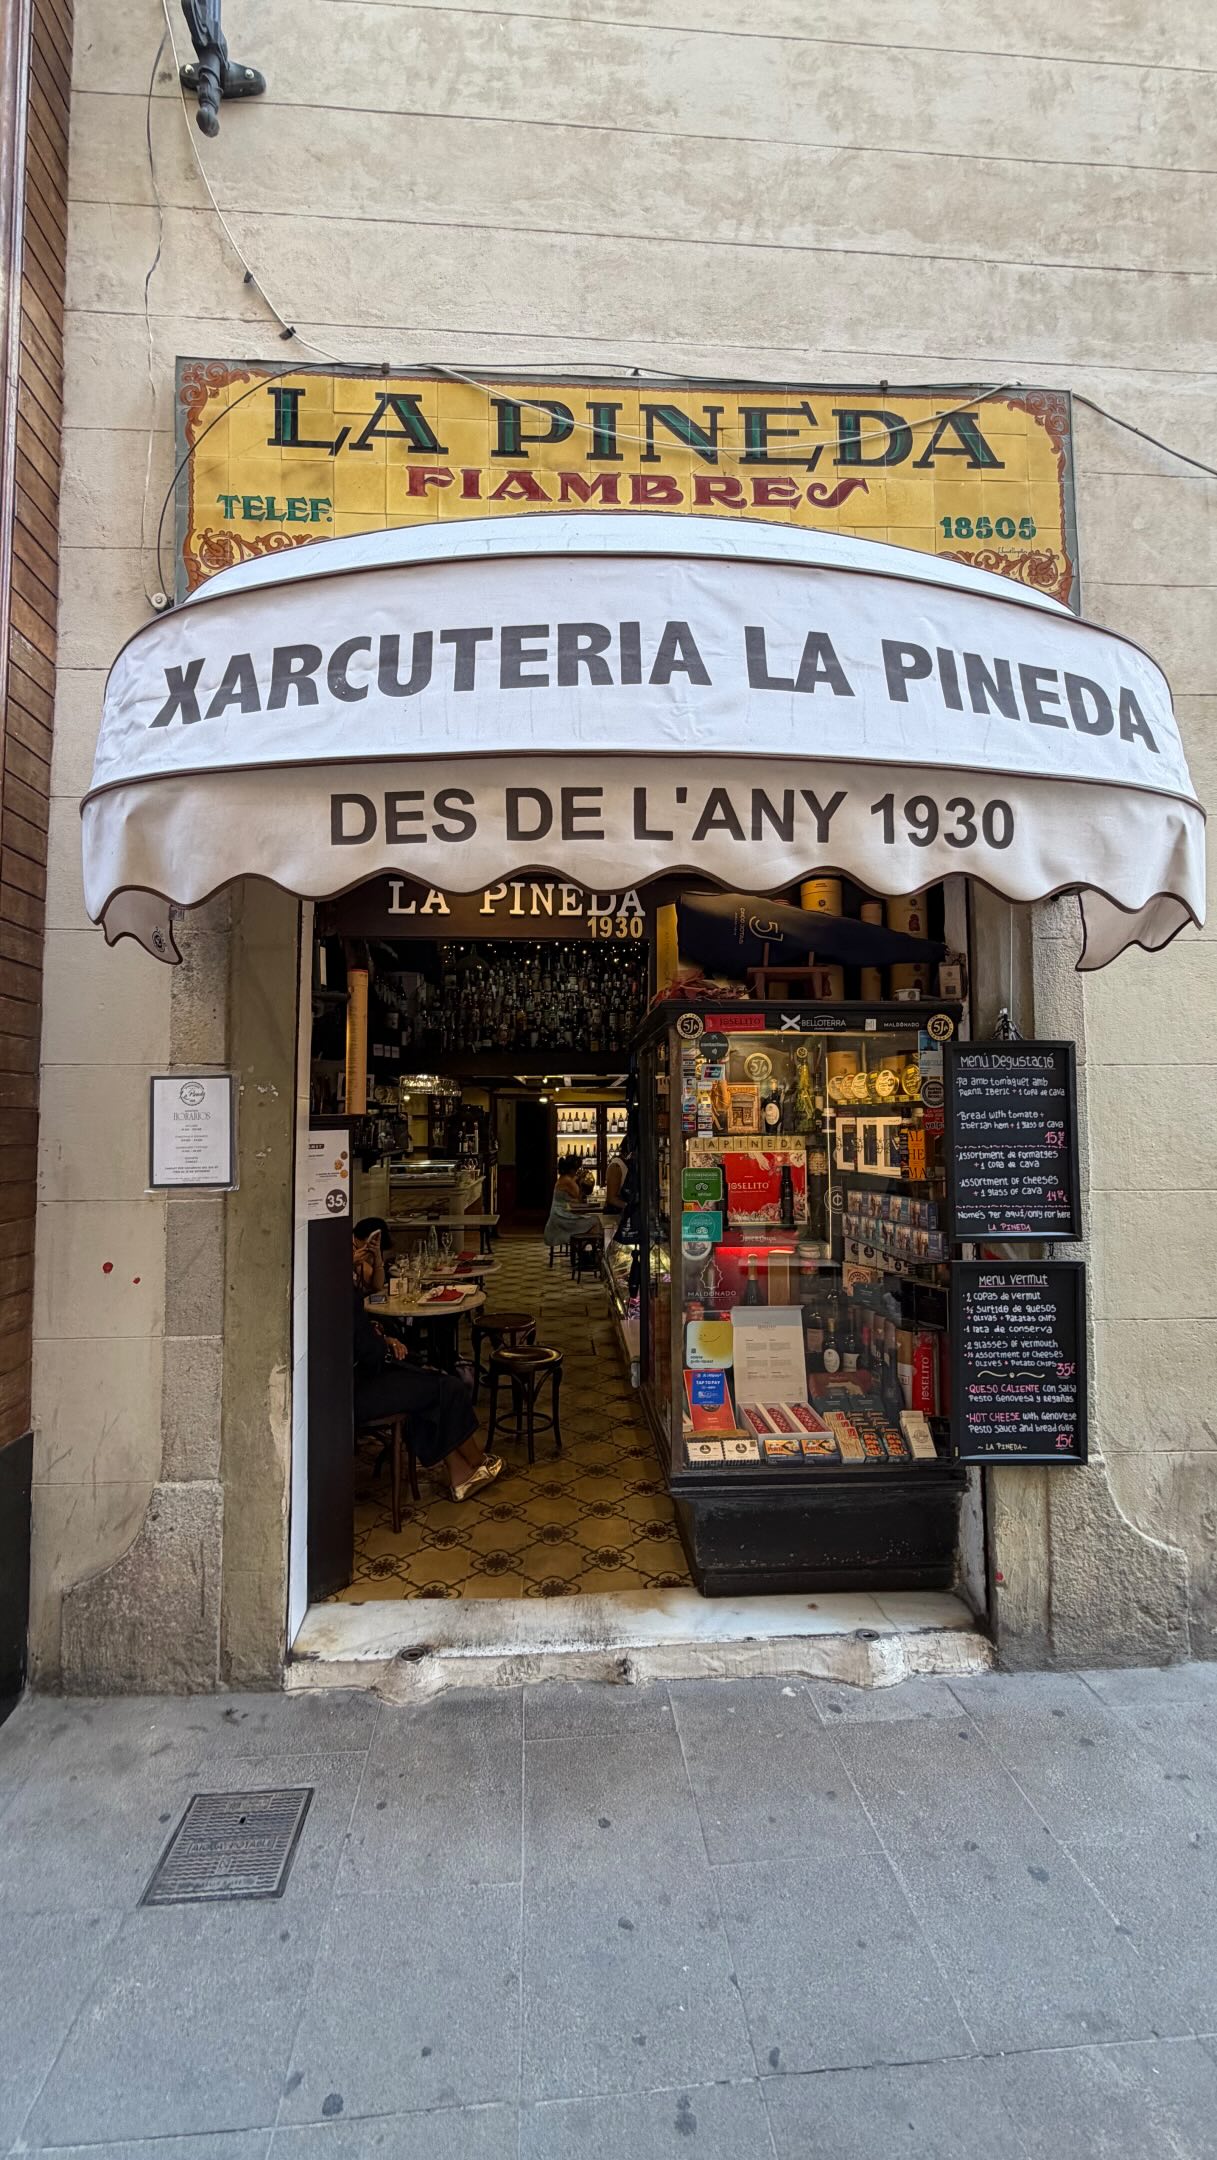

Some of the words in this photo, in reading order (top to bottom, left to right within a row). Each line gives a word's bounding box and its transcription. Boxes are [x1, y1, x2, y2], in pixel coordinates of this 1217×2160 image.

[266, 386, 448, 455] LA
[488, 397, 1005, 472] PINEDA
[404, 465, 868, 508] FIAMBRES
[216, 495, 331, 522] TELEF.
[939, 514, 1035, 540] 18505
[149, 619, 711, 728] XARCUTERIA
[742, 623, 855, 696] LA
[880, 637, 1159, 752] PINEDA
[329, 785, 476, 844] DES
[504, 785, 603, 839] DE
[631, 784, 846, 841] L'ANY
[867, 794, 1014, 850] 1930
[388, 881, 450, 914] LA
[479, 882, 645, 917] PINEDA
[587, 917, 642, 938] 1930
[801, 1019, 846, 1028] BELLOTERRA
[991, 1053, 1055, 1070] Degustació
[173, 1112, 211, 1121] HORARIOS
[1008, 1110, 1039, 1119] tomato
[728, 1182, 769, 1190] JOSELITO
[1000, 1223, 1032, 1232] PINEDA
[687, 1290, 737, 1298] MALDONADO
[1008, 1325, 1053, 1334] conserva
[921, 1356, 930, 1401] JOSELITO
[969, 1384, 999, 1394] QUESO
[1000, 1384, 1040, 1393] CALIENTE
[969, 1413, 987, 1423] HOT
[989, 1412, 1020, 1422] CHEESE
[996, 1443, 1023, 1451] PINEDA
